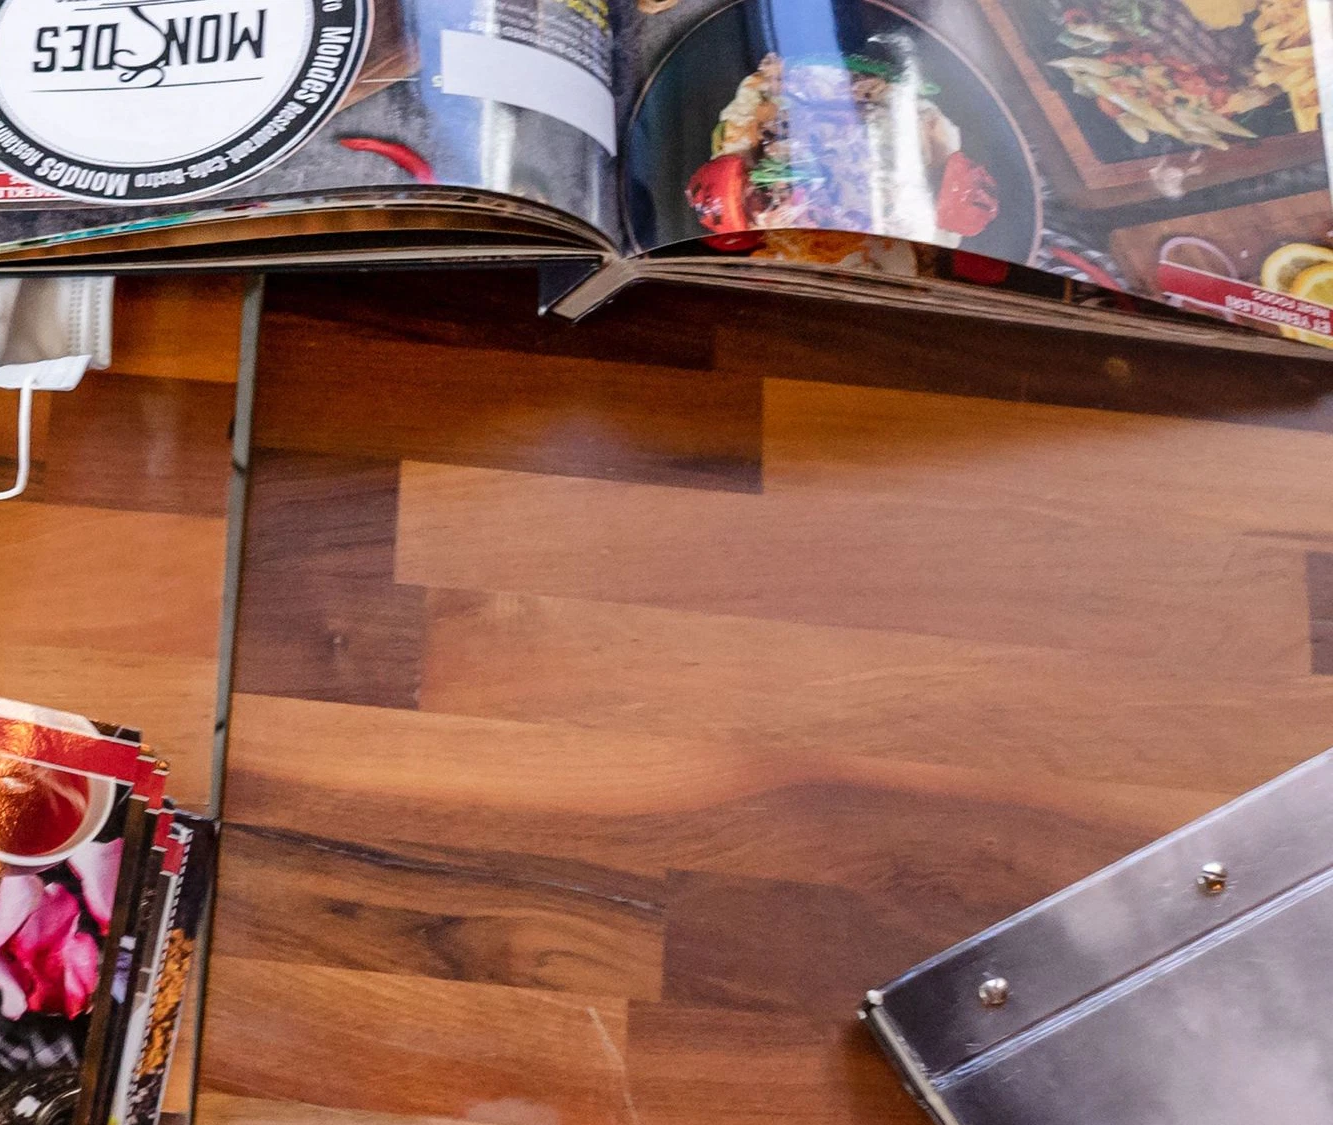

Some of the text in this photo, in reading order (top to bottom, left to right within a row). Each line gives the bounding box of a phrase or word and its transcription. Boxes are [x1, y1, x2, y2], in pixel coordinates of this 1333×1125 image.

[32, 8, 267, 73] MONDES
[292, 26, 353, 104] Mondes
[34, 157, 131, 197] Mondes
